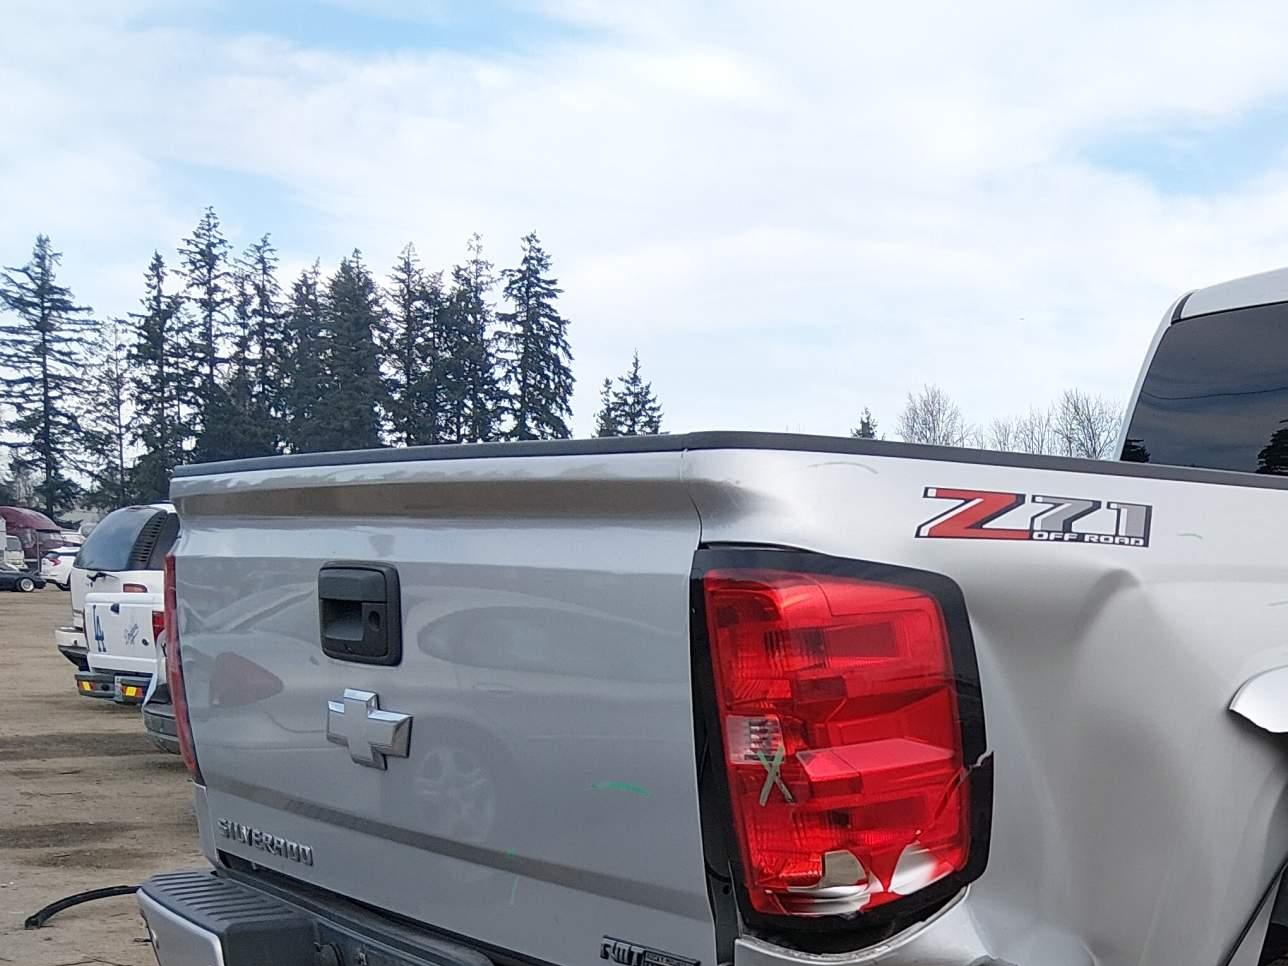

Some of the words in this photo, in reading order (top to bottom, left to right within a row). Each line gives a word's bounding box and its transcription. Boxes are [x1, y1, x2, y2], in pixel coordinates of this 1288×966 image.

[915, 487, 1152, 543] Z71
[1032, 531, 1078, 542] OFF
[1084, 534, 1145, 546] ROAD
[217, 817, 314, 866] SILVERADO
